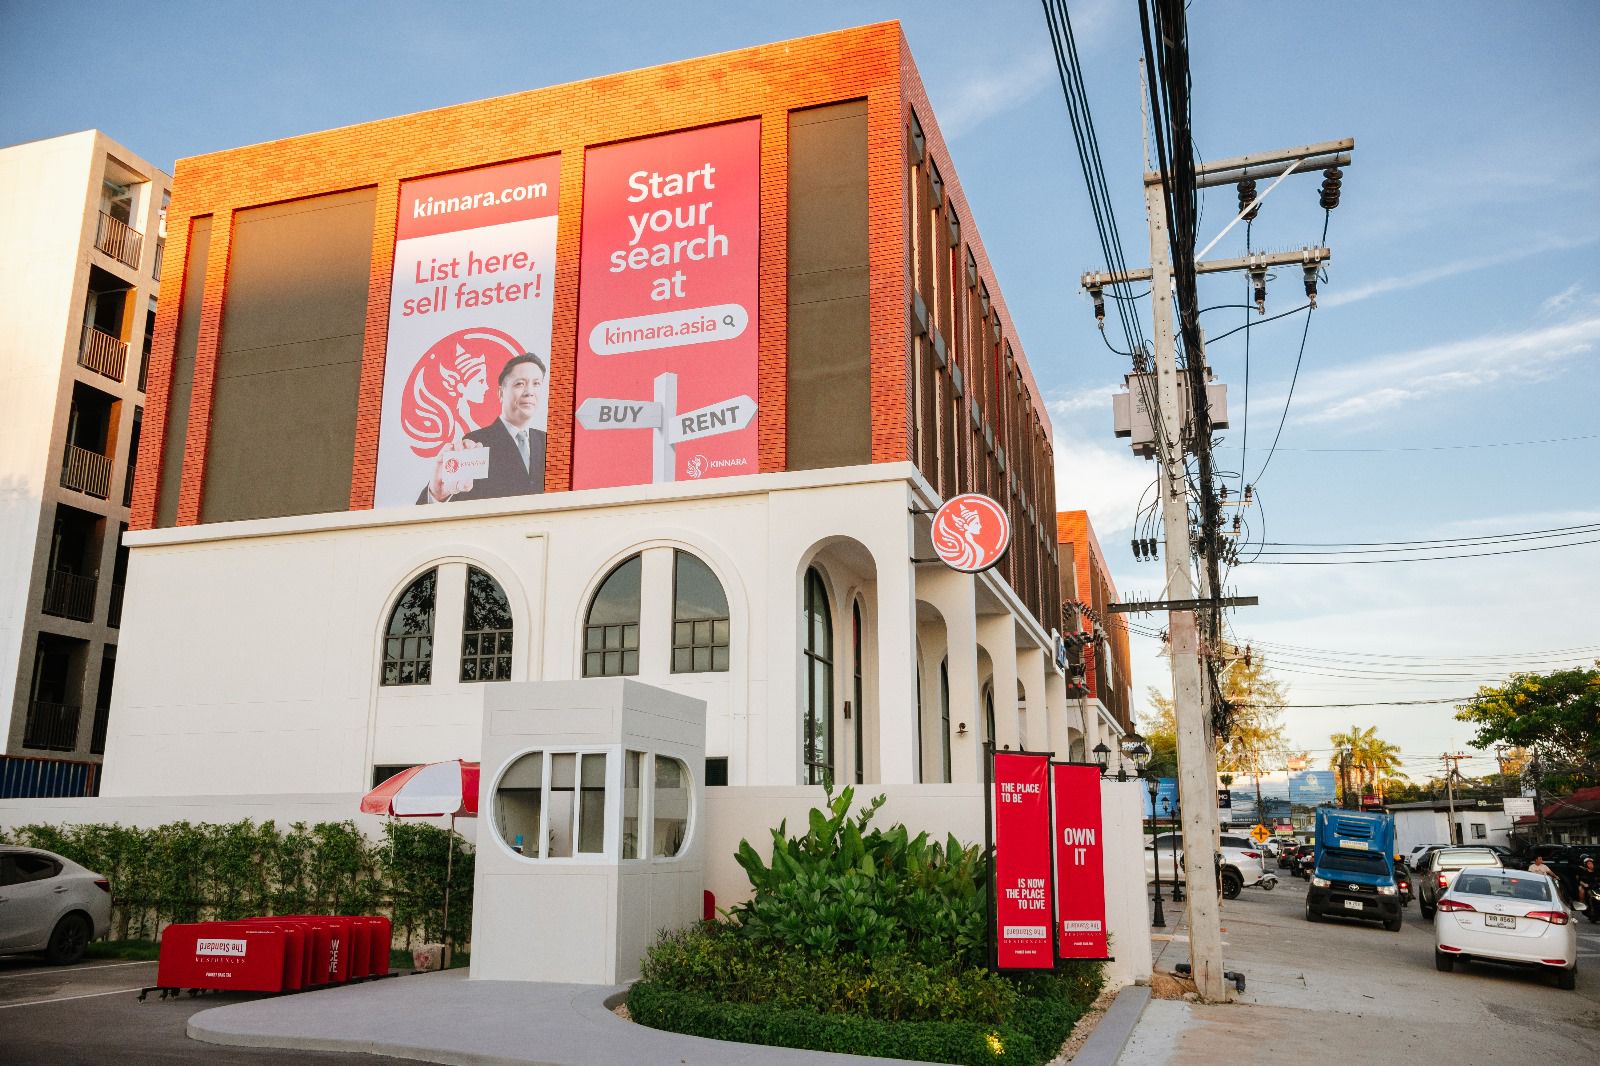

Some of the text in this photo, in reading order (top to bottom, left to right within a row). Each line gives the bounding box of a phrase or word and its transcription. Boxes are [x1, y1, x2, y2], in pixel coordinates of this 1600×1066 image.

[627, 162, 716, 203] Start
[412, 180, 548, 219] kinnara.com
[628, 201, 713, 246] your
[609, 225, 729, 273] search
[415, 250, 537, 285] List here,
[402, 273, 542, 316] sell faster!
[650, 270, 686, 302] at
[605, 316, 718, 346] kinnara.asia
[599, 405, 644, 424] BUY
[681, 405, 741, 436] RENT
[710, 456, 749, 468] KINNARA
[1001, 782, 1040, 794] THE PLACE
[1001, 793, 1023, 804] TO BE
[1064, 827, 1096, 846] OWN
[1074, 848, 1087, 866] IT
[1018, 878, 1045, 889] IS NOW
[1006, 888, 1046, 899] THE PLACE
[1018, 899, 1046, 910] TO LIVE
[199, 942, 244, 953] The Standard
